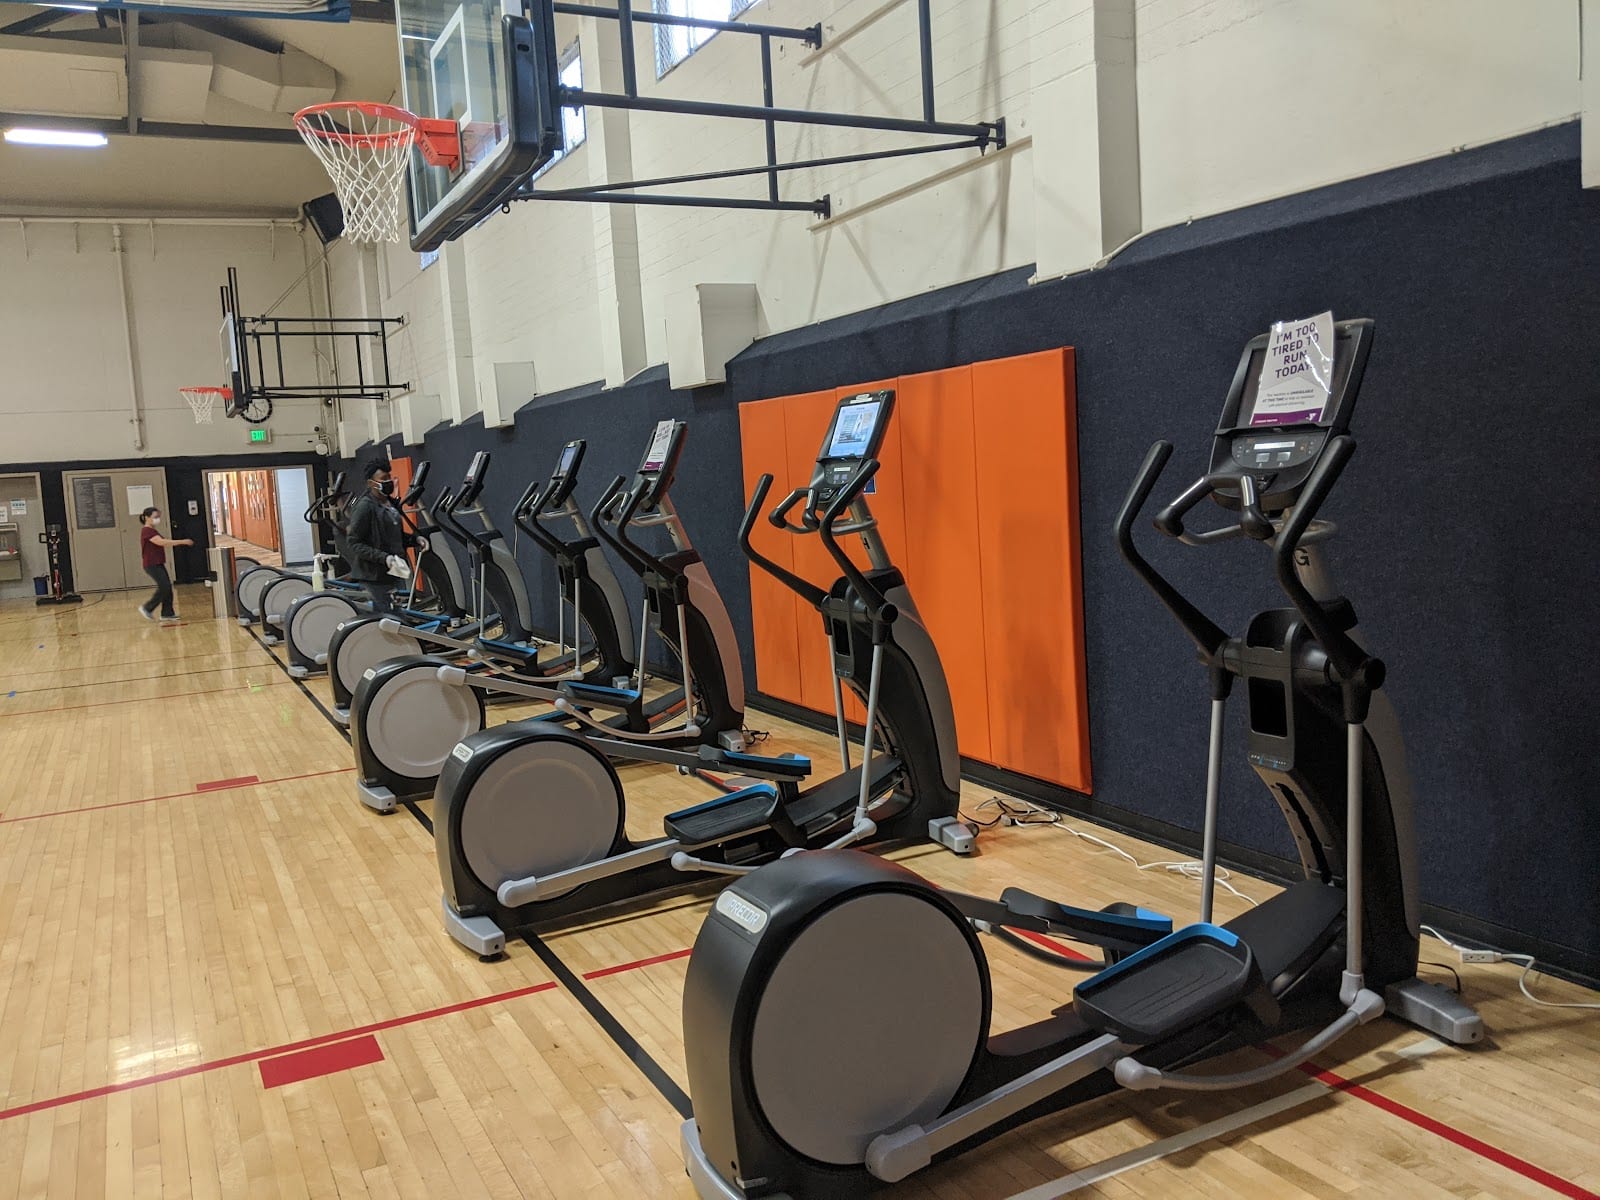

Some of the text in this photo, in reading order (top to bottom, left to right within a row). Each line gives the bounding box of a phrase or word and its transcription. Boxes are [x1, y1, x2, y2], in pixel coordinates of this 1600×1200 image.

[1276, 322, 1316, 344] I'M TOO
[1272, 333, 1319, 356] TIRED TO
[1283, 350, 1307, 365] RUN
